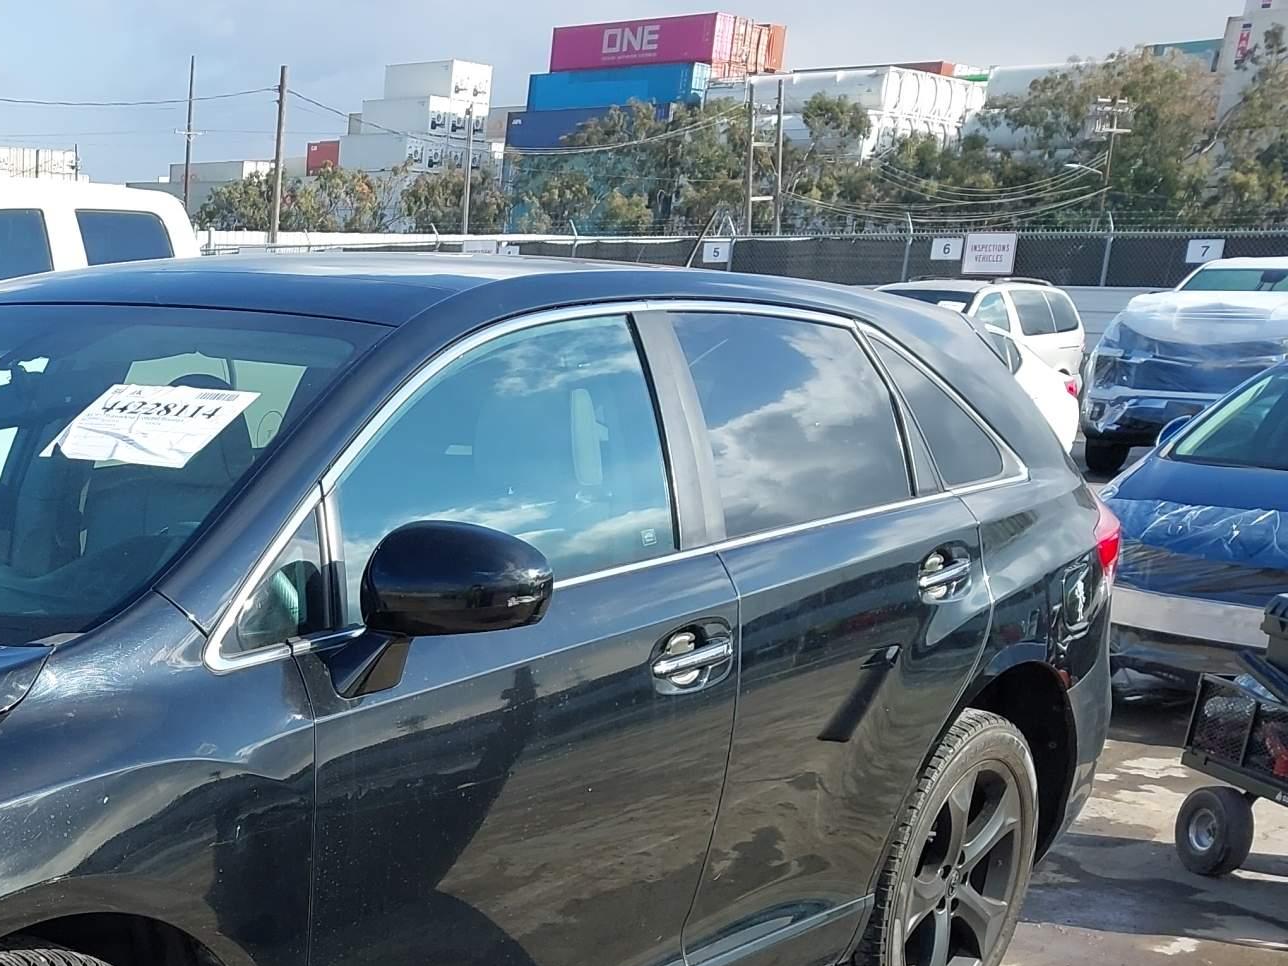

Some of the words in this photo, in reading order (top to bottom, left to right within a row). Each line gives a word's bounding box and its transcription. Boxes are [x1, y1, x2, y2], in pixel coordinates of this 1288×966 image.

[601, 24, 661, 54] ONE
[712, 246, 721, 258] 5
[942, 243, 952, 255] 6
[970, 243, 1011, 253] INSPECTIONS
[1200, 245, 1211, 257] 7
[974, 254, 1004, 264] VEHICLES
[101, 400, 223, 420] 44228114
